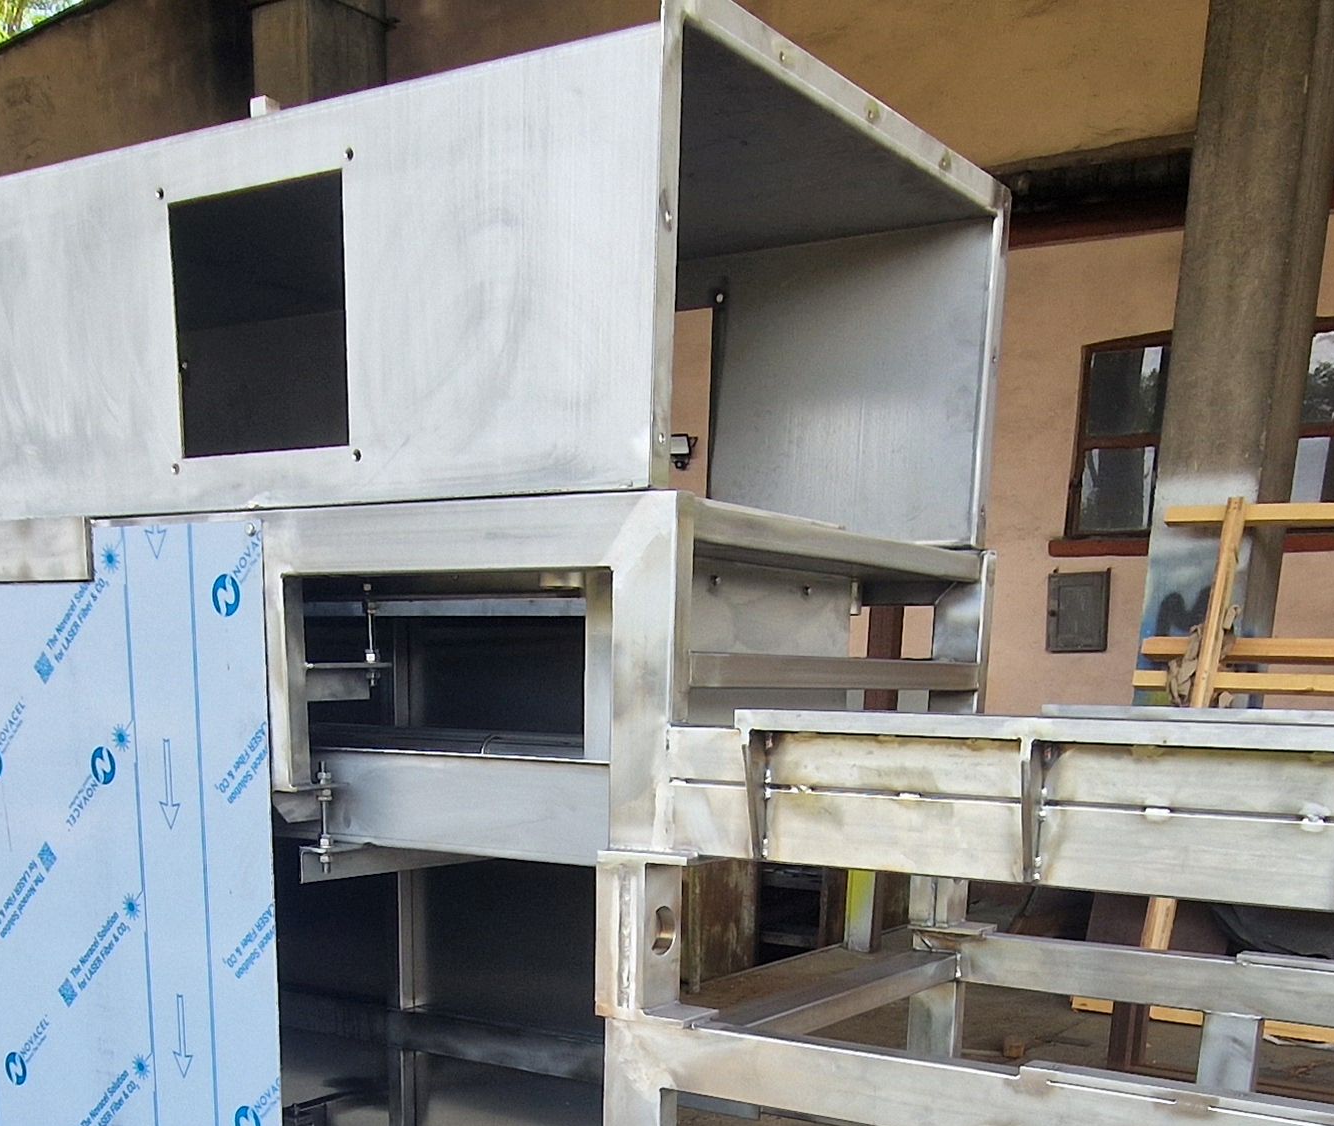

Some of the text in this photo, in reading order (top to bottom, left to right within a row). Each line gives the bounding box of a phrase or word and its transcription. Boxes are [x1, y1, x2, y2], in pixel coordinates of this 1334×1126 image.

[227, 770, 235, 780] &
[233, 748, 250, 772] Fiber
[66, 780, 99, 828] NOVACEL
[227, 770, 253, 804] Solution
[71, 913, 119, 978] The Novacel Solution
[240, 927, 257, 949] Fiber
[78, 979, 87, 990] for
[85, 955, 103, 980] LASER
[101, 940, 115, 959] Fiber
[234, 948, 260, 979] Solution
[20, 1017, 49, 1057] NOVACEL
[90, 1094, 109, 1119] Novacel
[108, 1072, 128, 1097] Solution
[111, 1097, 125, 1114] Fiber
